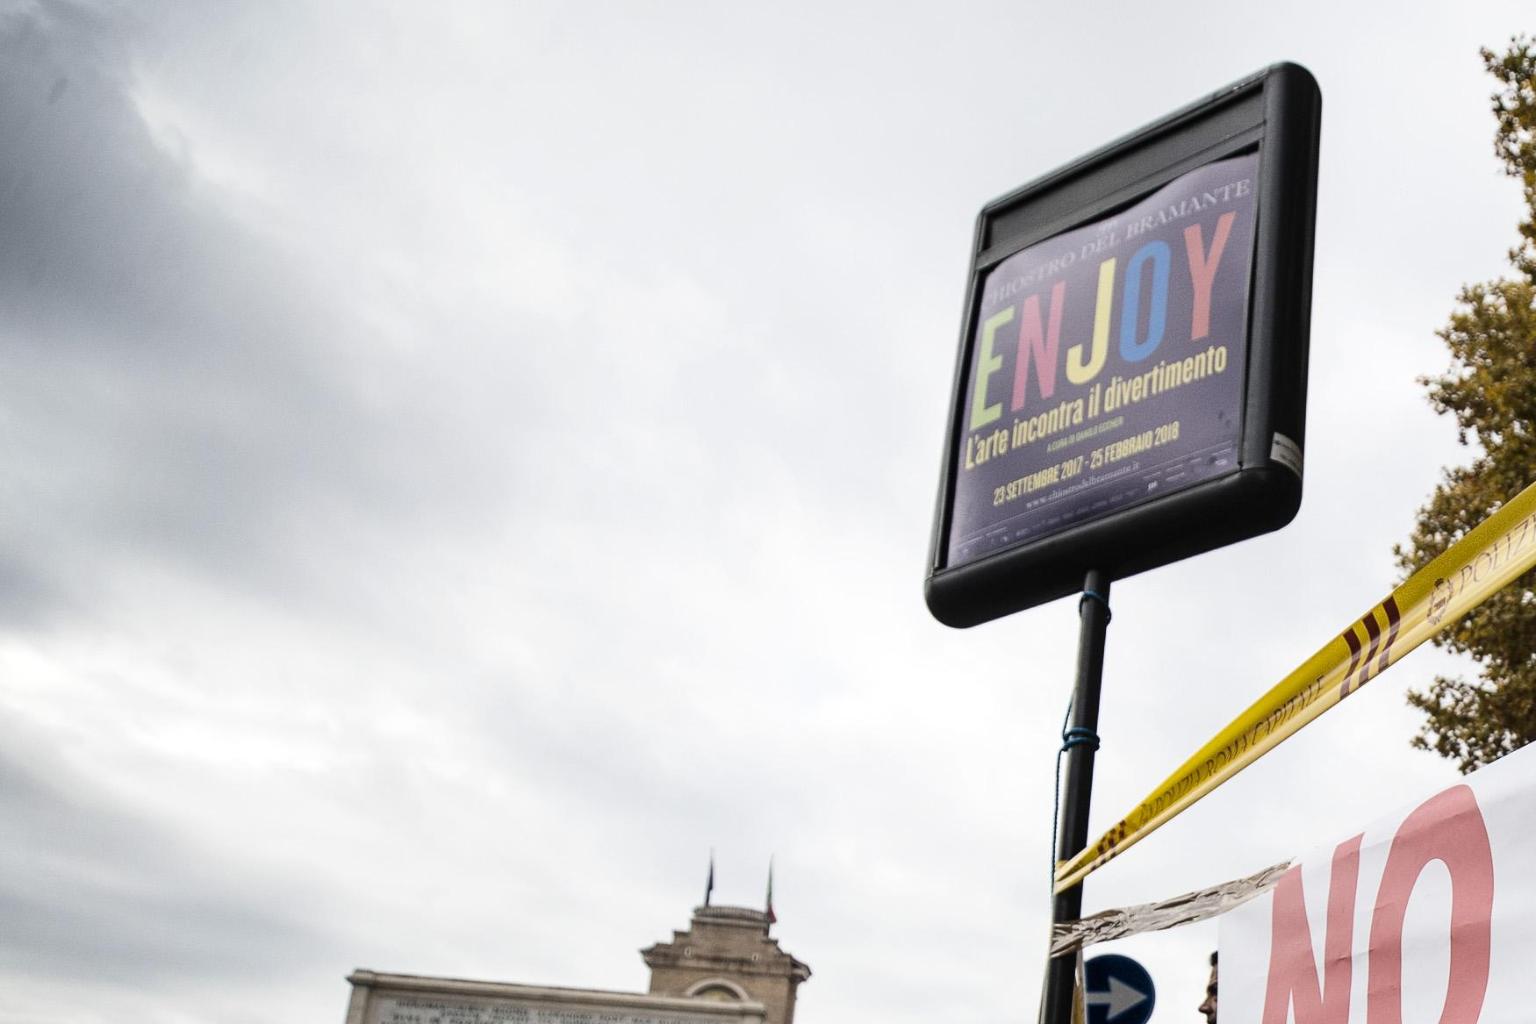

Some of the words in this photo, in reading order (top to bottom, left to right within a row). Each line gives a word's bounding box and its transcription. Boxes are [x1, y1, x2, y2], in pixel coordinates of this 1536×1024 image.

[1081, 230, 1122, 260] DEL
[1126, 178, 1251, 240] BRAMANTE
[969, 210, 1237, 431] ENJOY
[964, 429, 1008, 470] L'arte
[1011, 398, 1083, 450] incontra
[1087, 383, 1101, 420] il
[1104, 345, 1228, 413] divertimento
[993, 486, 1005, 506] 23
[1005, 463, 1060, 501] SETTEMBRE
[1060, 455, 1084, 481] 2017
[1090, 448, 1103, 470] 25
[1104, 431, 1154, 464] FEBBRAIO
[1154, 420, 1180, 449] 2018
